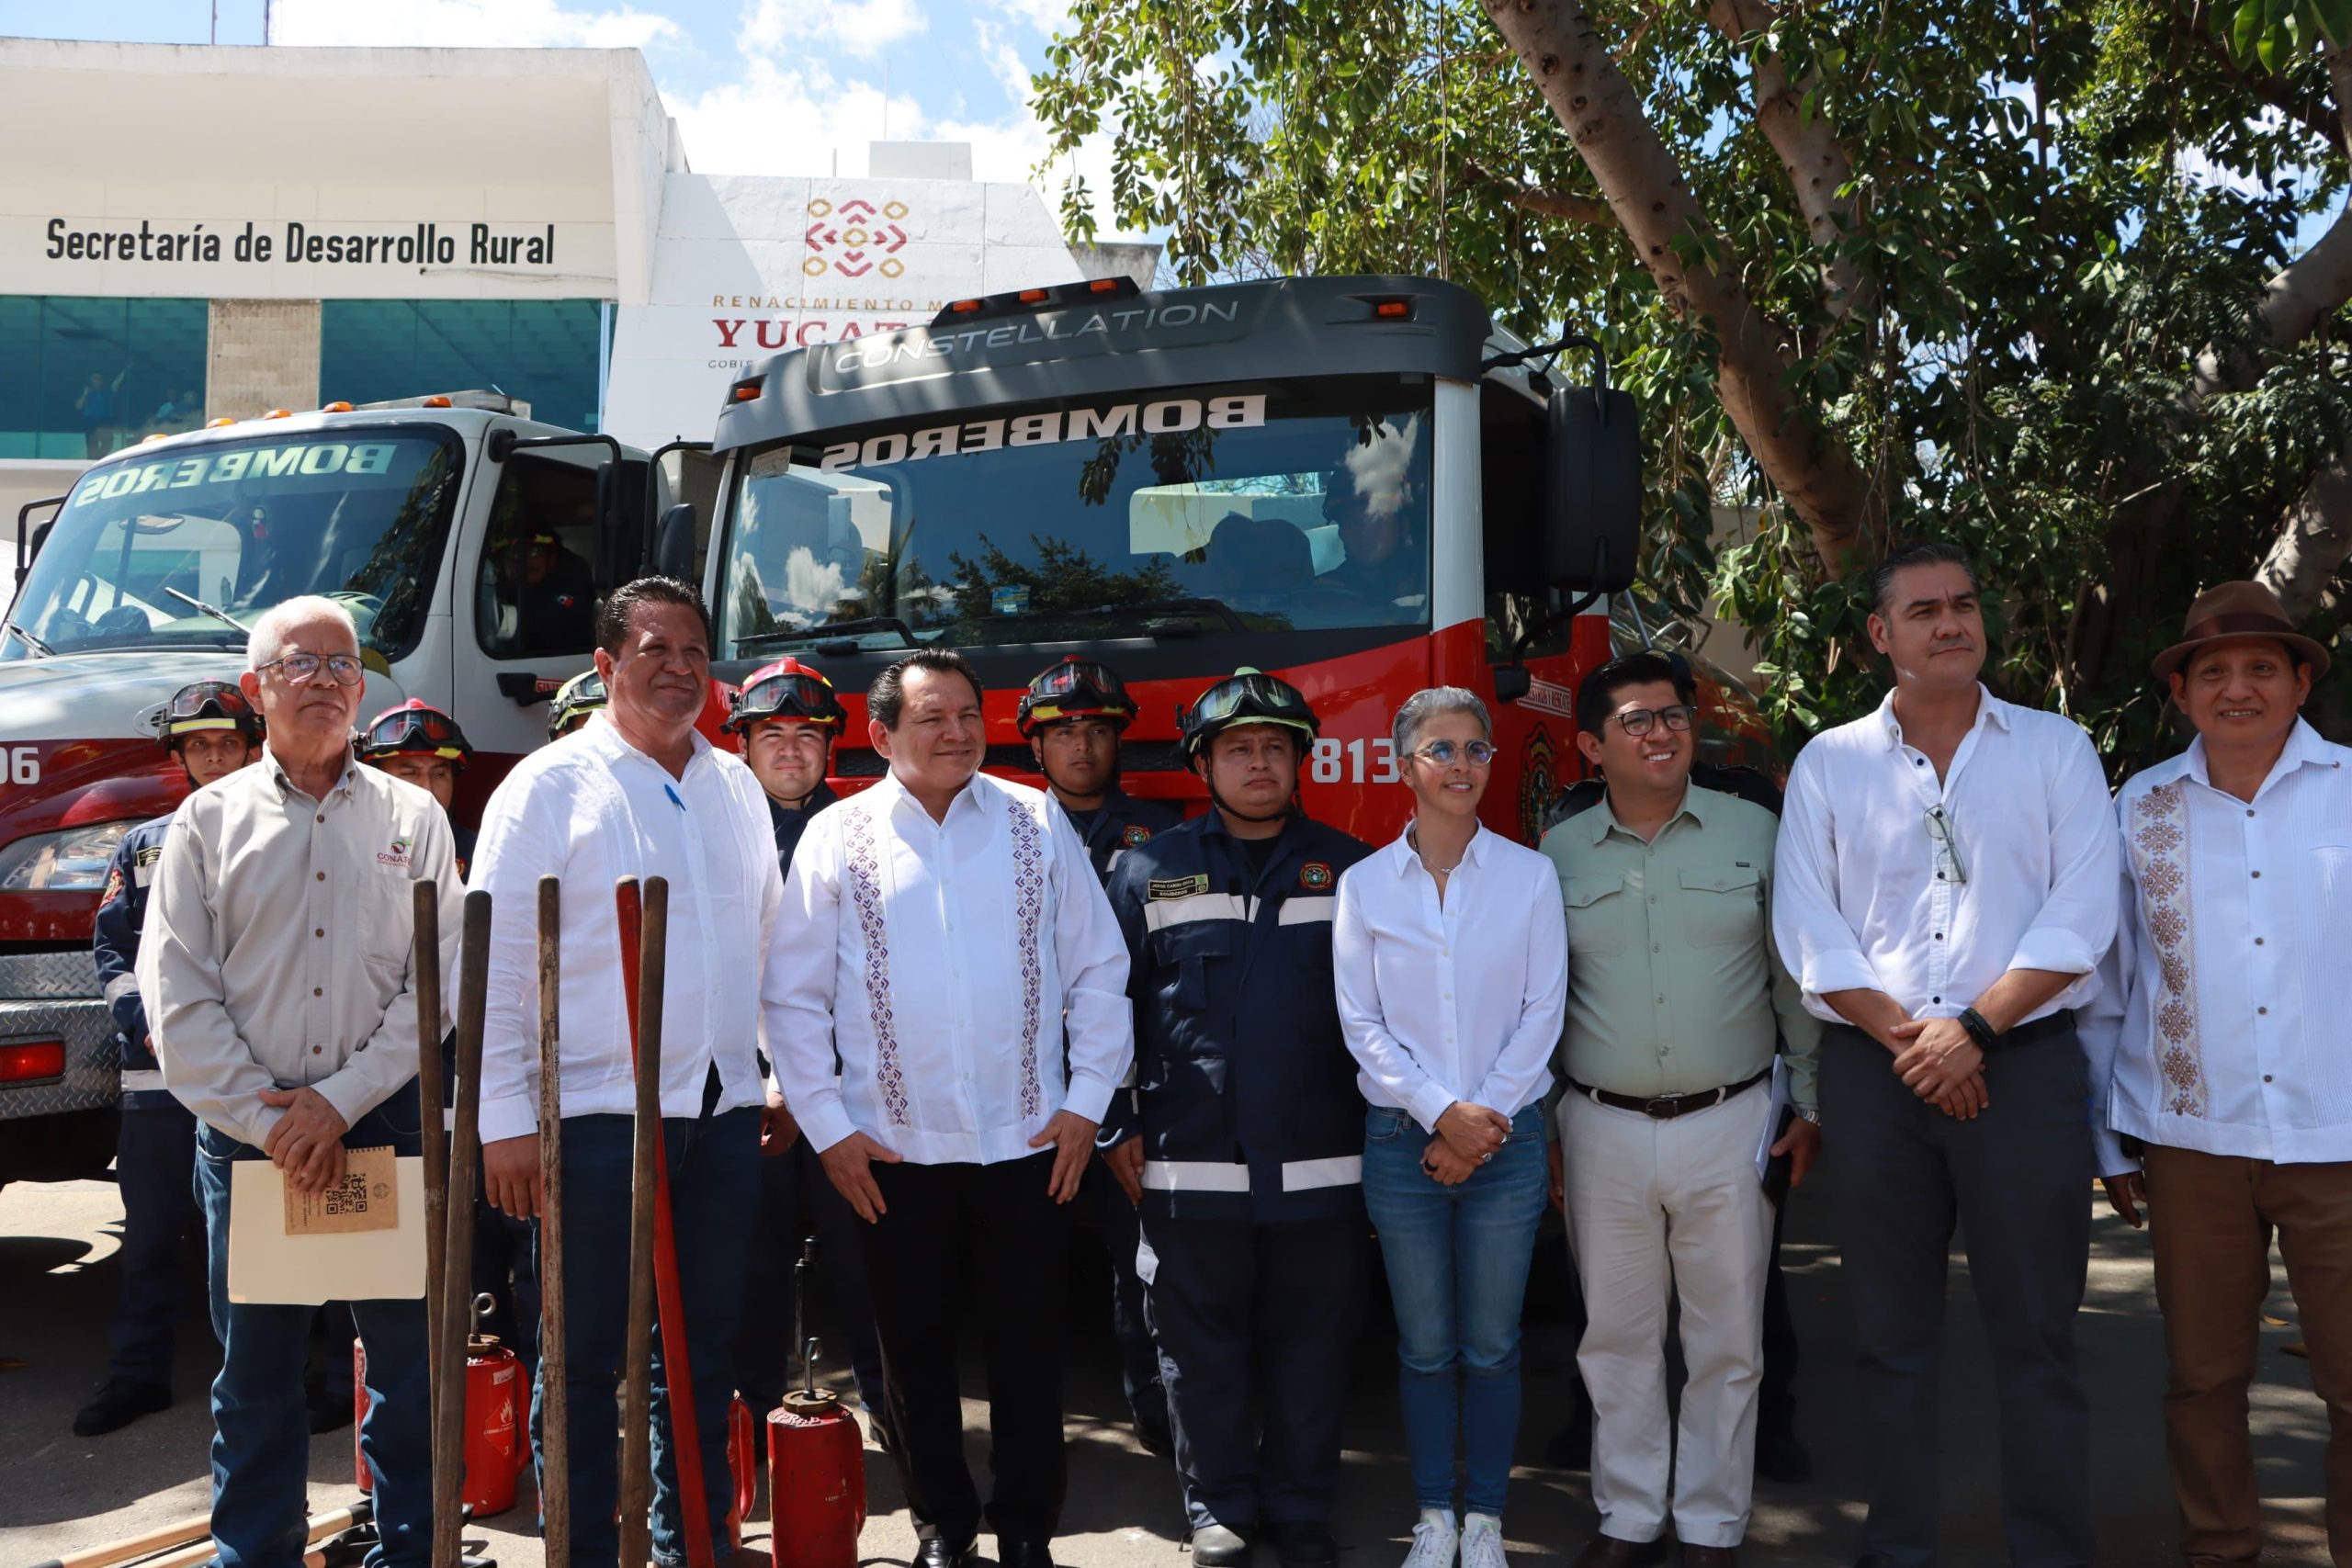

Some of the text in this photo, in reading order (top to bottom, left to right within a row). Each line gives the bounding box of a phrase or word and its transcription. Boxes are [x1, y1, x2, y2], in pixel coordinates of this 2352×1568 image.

[47, 218, 554, 265] Secretaría de Desarrollo Rural
[712, 295, 913, 312] RENACIMIENTO
[834, 299, 1238, 374] CONSTELLATION
[1312, 739, 1401, 784] 813
